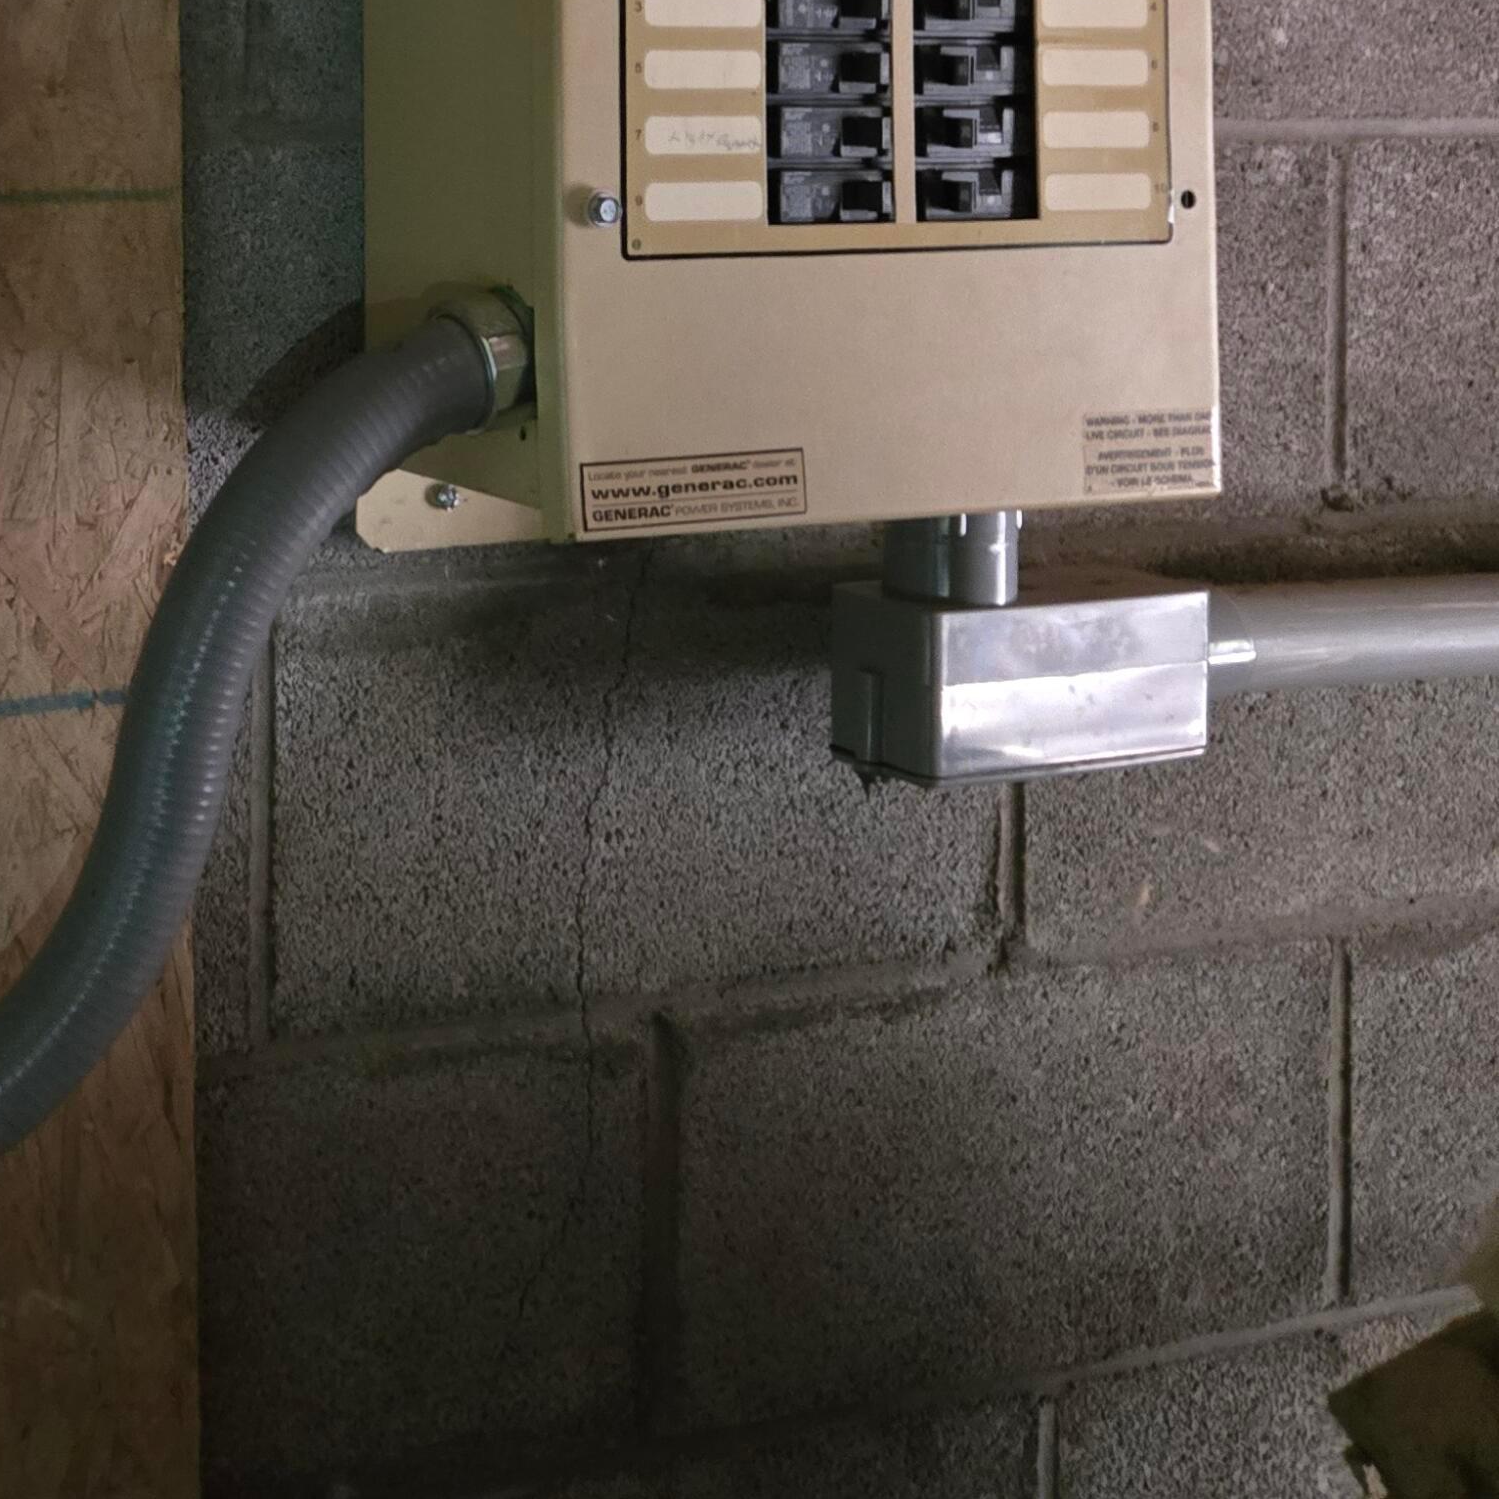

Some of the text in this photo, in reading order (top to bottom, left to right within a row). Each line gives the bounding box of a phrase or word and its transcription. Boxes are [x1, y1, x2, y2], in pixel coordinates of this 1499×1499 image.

[691, 461, 747, 473] GENERAC
[591, 474, 798, 499] www.generac.com
[592, 505, 671, 522] GENERAC
[675, 503, 717, 517] POWER
